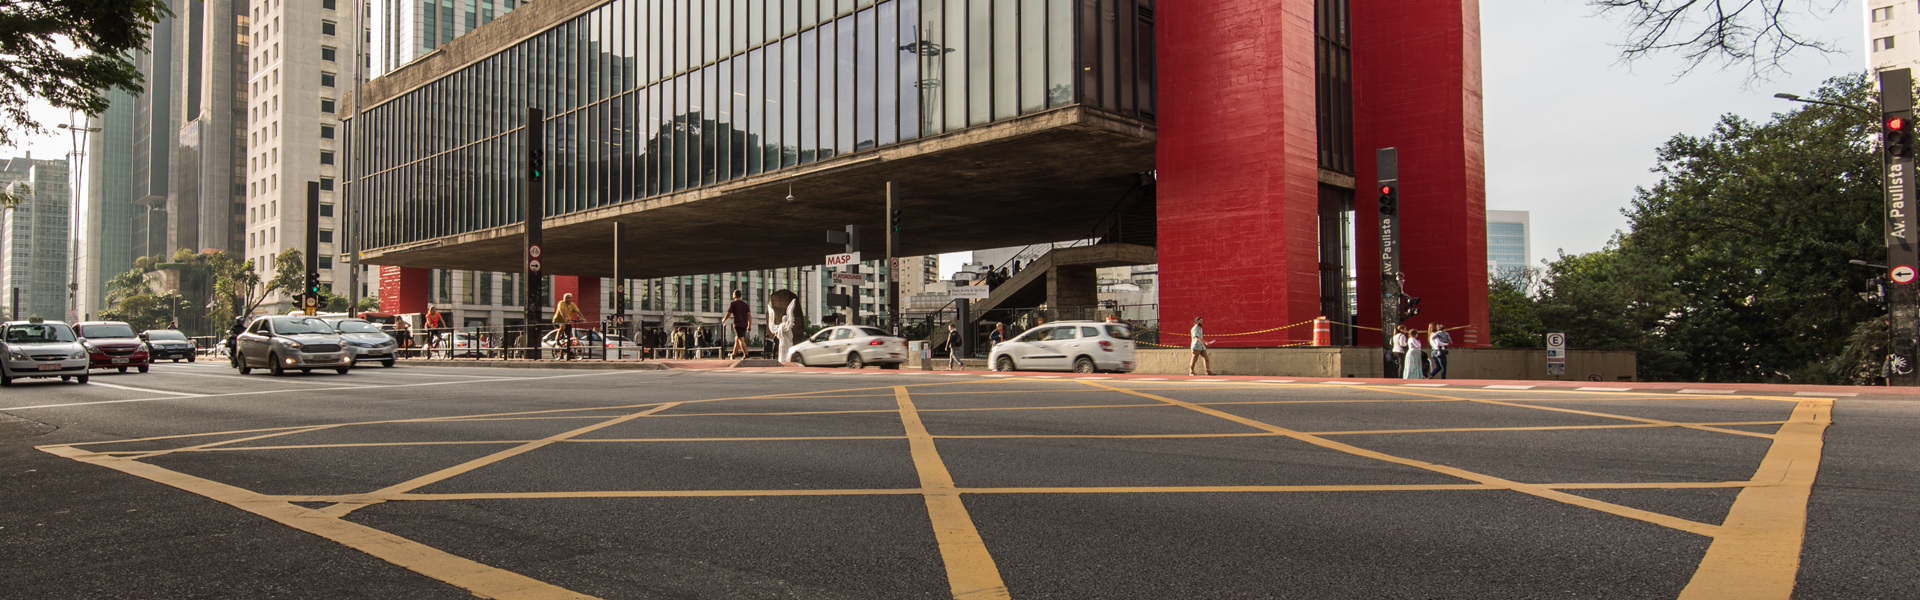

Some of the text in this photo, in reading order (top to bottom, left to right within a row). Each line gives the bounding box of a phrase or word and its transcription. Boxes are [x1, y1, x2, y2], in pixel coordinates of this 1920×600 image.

[1888, 164, 1906, 238] Av. Paulista
[827, 255, 851, 266] MASP
[1382, 218, 1393, 275] Av. Paulista
